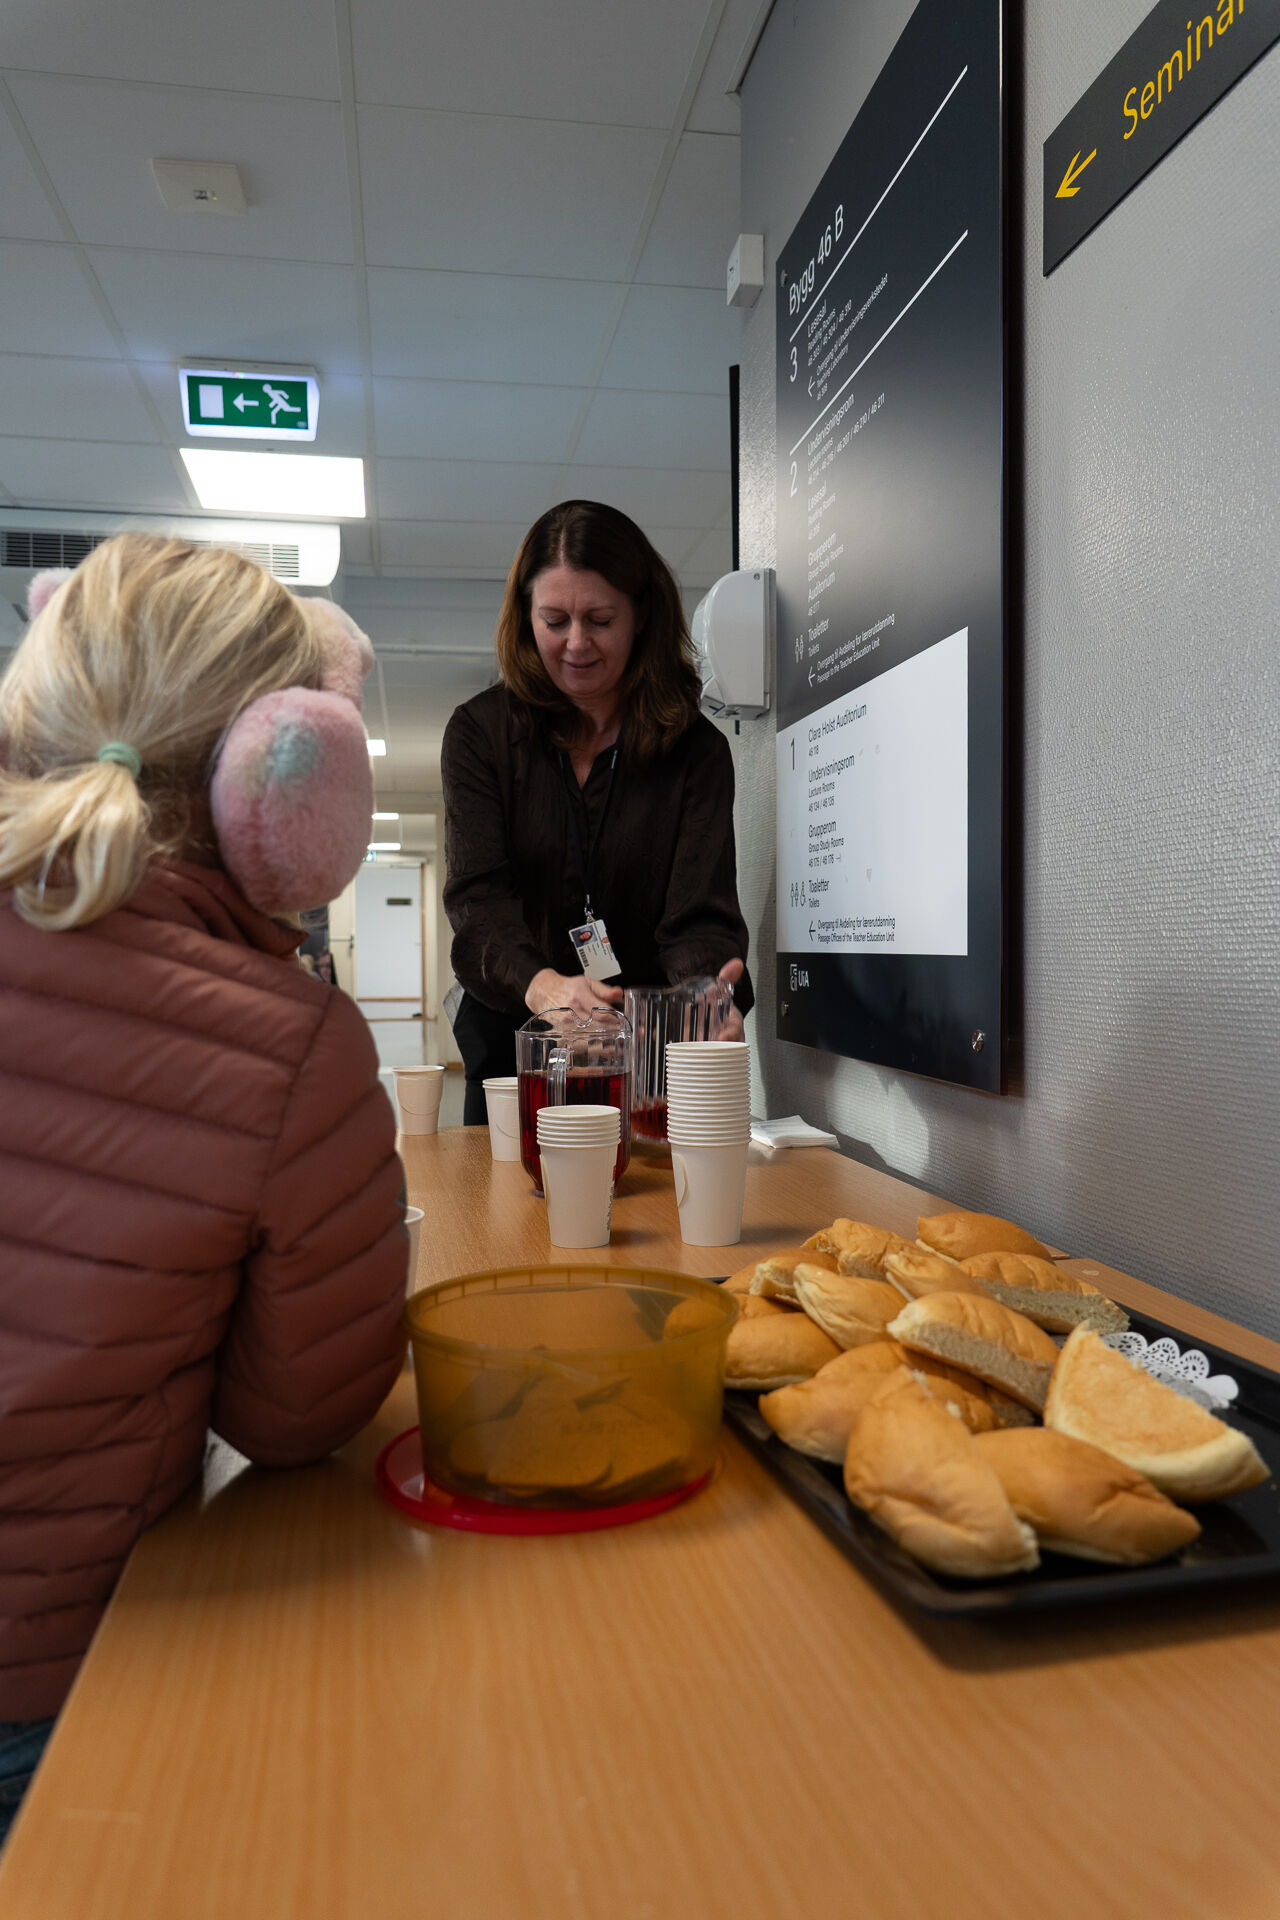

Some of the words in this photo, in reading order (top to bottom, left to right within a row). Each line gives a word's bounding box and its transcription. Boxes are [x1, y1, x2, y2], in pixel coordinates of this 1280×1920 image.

[790, 257, 814, 317] Bygg
[818, 222, 832, 266] 46
[835, 202, 843, 243] B
[808, 297, 826, 340] Lesesal
[790, 345, 798, 384] 3
[808, 392, 854, 457] Undervisningsrom
[837, 440, 842, 454] 46
[854, 420, 859, 434] 46
[871, 401, 876, 415] 46
[808, 452, 820, 473] Lecture
[790, 460, 797, 499] 2
[808, 479, 826, 514] Lesesal
[808, 532, 836, 567] Grupperom
[808, 572, 835, 604] Auditorium
[808, 618, 829, 643] Toaletter
[817, 654, 833, 672] Overgang
[839, 640, 855, 658] Avdeling
[862, 613, 894, 643] lærerutdanning
[808, 643, 819, 658] Toilets
[817, 671, 830, 685] Passage
[840, 656, 852, 670] Teacher
[854, 645, 871, 662] Education
[809, 728, 820, 743] Clara
[822, 717, 835, 737] Holst
[837, 704, 866, 729] Auditorium
[791, 738, 794, 770] 1
[809, 755, 854, 783] Undervisningsrom
[809, 787, 821, 798] Lecture
[822, 782, 834, 793] Rooms
[809, 803, 813, 813] 46
[823, 798, 827, 808] 46
[809, 821, 836, 839] Grupperom
[809, 844, 819, 853] Group
[820, 840, 829, 850] Study
[831, 838, 844, 848] Rooms
[809, 858, 813, 867] 46
[823, 855, 827, 865] 46
[809, 878, 829, 893] Toaletter
[809, 898, 819, 908] Toilets
[818, 920, 834, 932] Overgang
[840, 918, 855, 931] Avdeling
[818, 934, 830, 944] Passage
[831, 934, 842, 942] Offices
[853, 933, 866, 942] Teacher
[867, 932, 885, 942] Education
[798, 970, 810, 987] UiA
